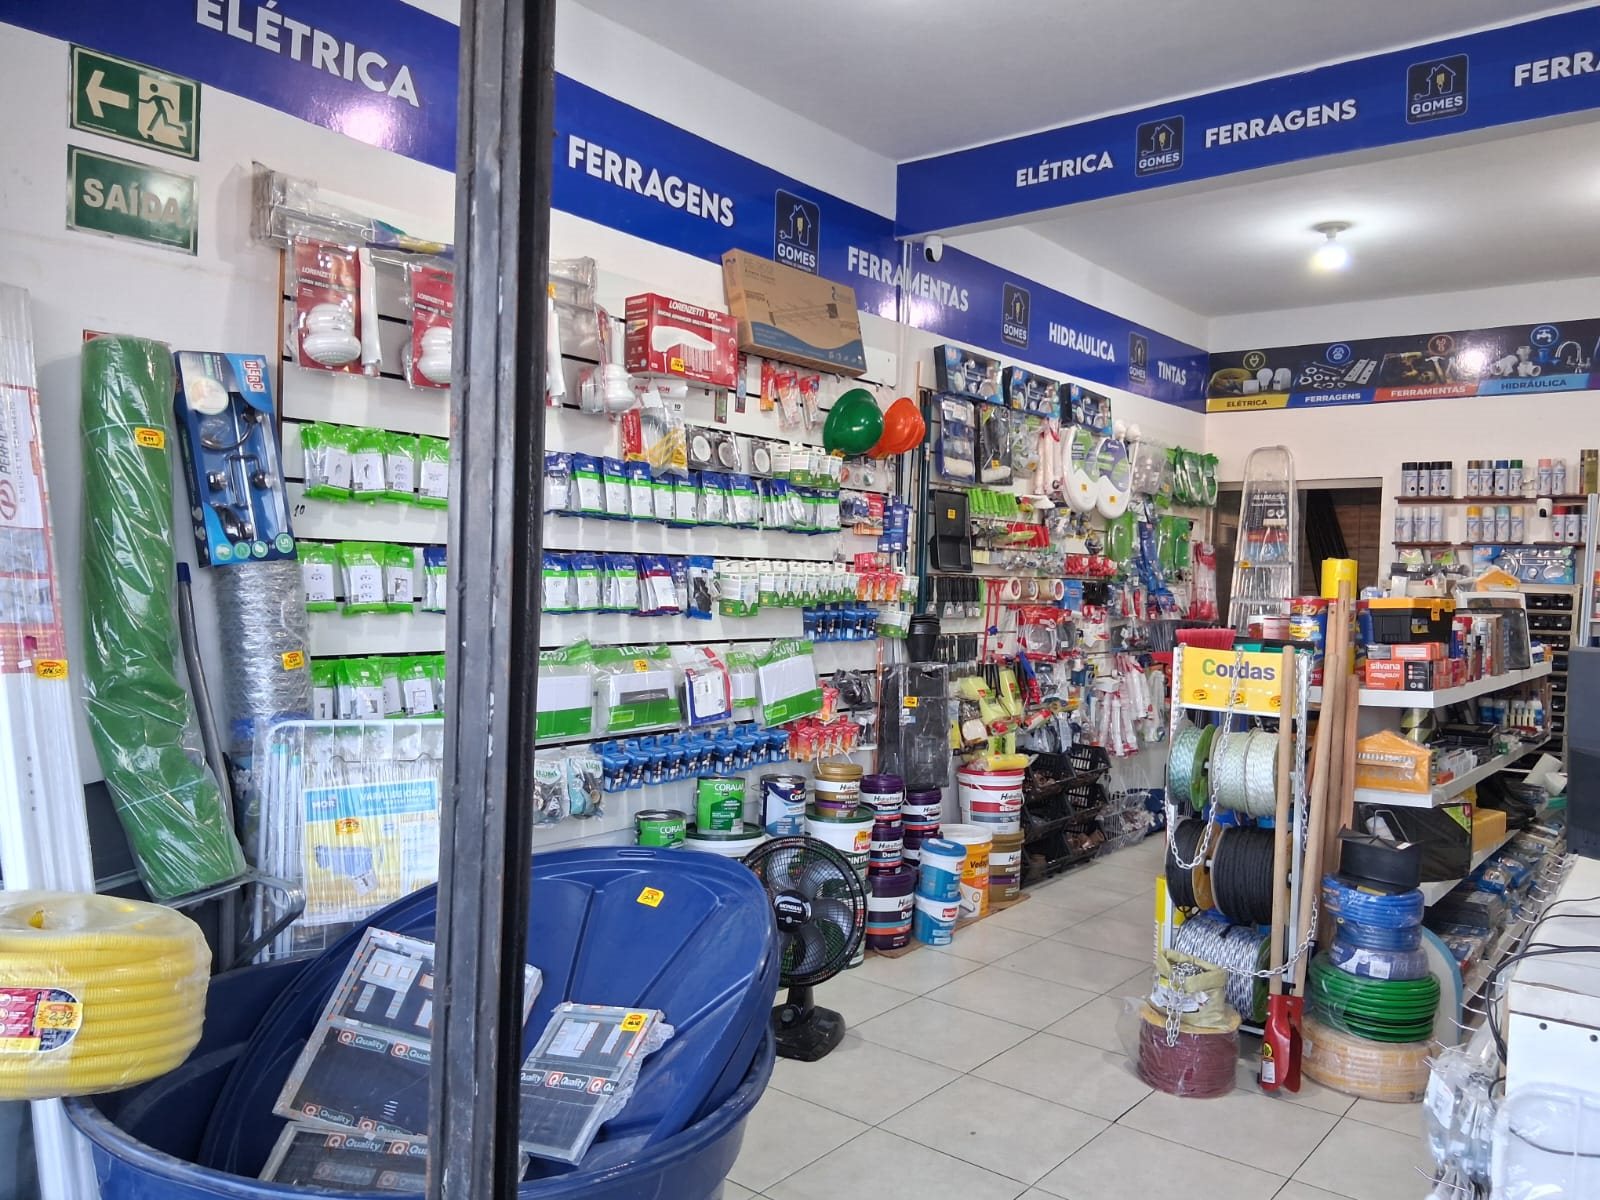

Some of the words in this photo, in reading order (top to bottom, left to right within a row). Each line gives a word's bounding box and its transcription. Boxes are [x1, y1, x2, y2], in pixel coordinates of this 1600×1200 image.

[197, 0, 420, 107] ELÉTRICA
[1411, 95, 1463, 115] GOMES
[1205, 98, 1357, 148] FERRAGENS
[1015, 150, 1114, 188] ELÉTRICA
[1138, 152, 1180, 169] GOMES
[568, 134, 735, 228] FERRAGENS
[83, 177, 184, 228] SAÍDA
[777, 243, 816, 268] GOMES
[847, 245, 969, 312] FERRAMENTAS
[668, 299, 705, 318] LORENZETTI
[1002, 323, 1028, 341] GOMES
[1049, 321, 1116, 363] HIDRAULICA
[244, 360, 264, 389] HERC
[1128, 365, 1146, 380] GOMES
[1157, 360, 1187, 386] TINTAS
[1390, 385, 1466, 398] FERRAMENTAS
[1500, 377, 1568, 391] HIDRÁULICA
[1225, 397, 1268, 408] ELÉTRICA
[1304, 392, 1361, 403] FERRAGENS
[1202, 658, 1276, 681] Cordas
[1370, 661, 1401, 671] silvana
[311, 799, 336, 809] MOR
[779, 903, 802, 911] MONDIAL
[356, 1036, 385, 1050] Quality
[560, 1076, 586, 1089] Quality
[320, 1109, 351, 1124] Quality
[345, 1138, 381, 1151] Quality
